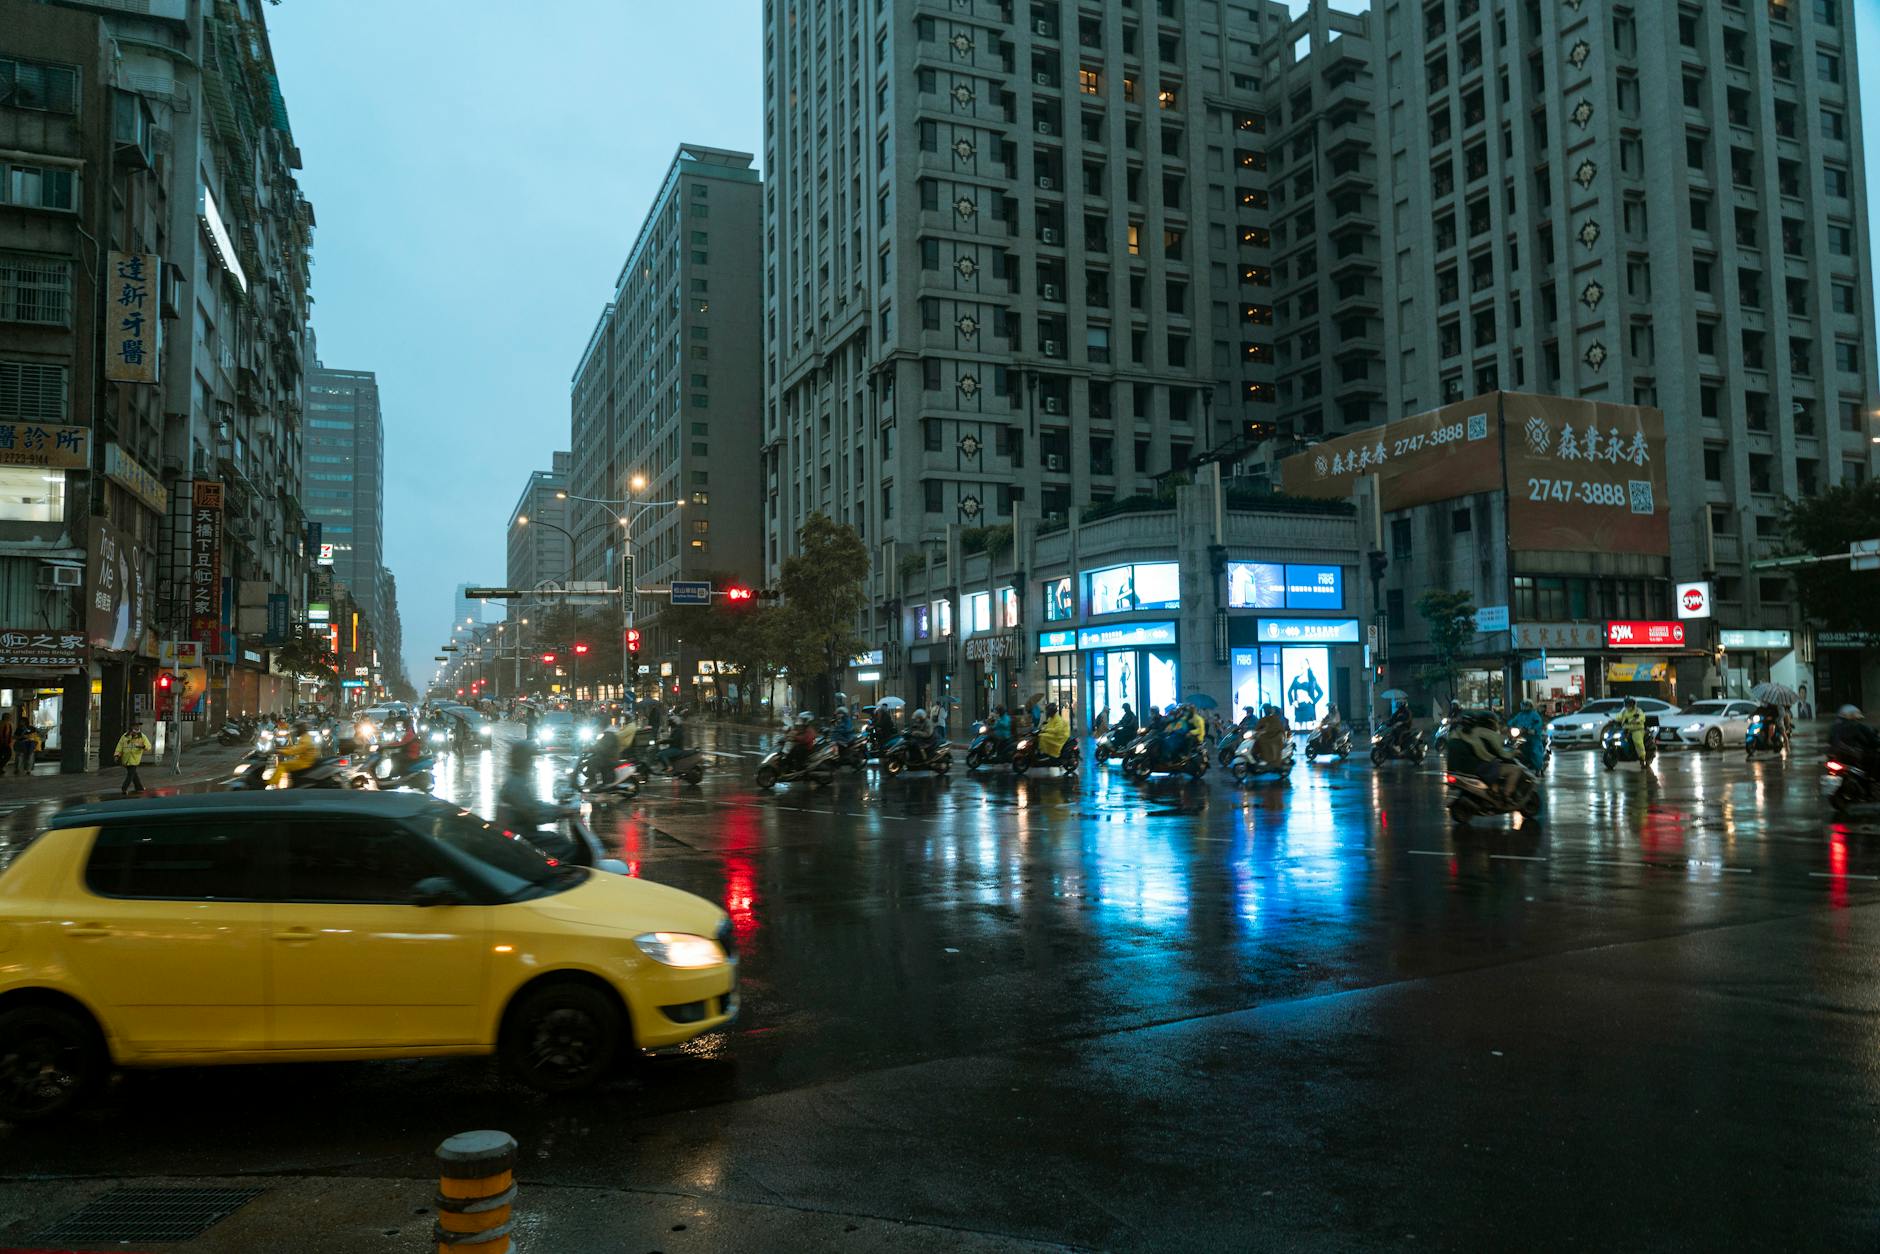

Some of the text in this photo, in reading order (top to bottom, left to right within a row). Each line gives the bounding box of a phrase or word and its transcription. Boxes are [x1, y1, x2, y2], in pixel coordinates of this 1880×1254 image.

[118, 256, 147, 366] 達新牙醫
[1394, 423, 1463, 456] 2747-3888
[1557, 422, 1650, 467] 森業永春
[1332, 441, 1388, 475] 森業永春
[1528, 478, 1625, 506] 2747-3888
[99, 560, 113, 589] Me
[1683, 595, 1704, 609] SYM
[1610, 624, 1633, 643] SYM
